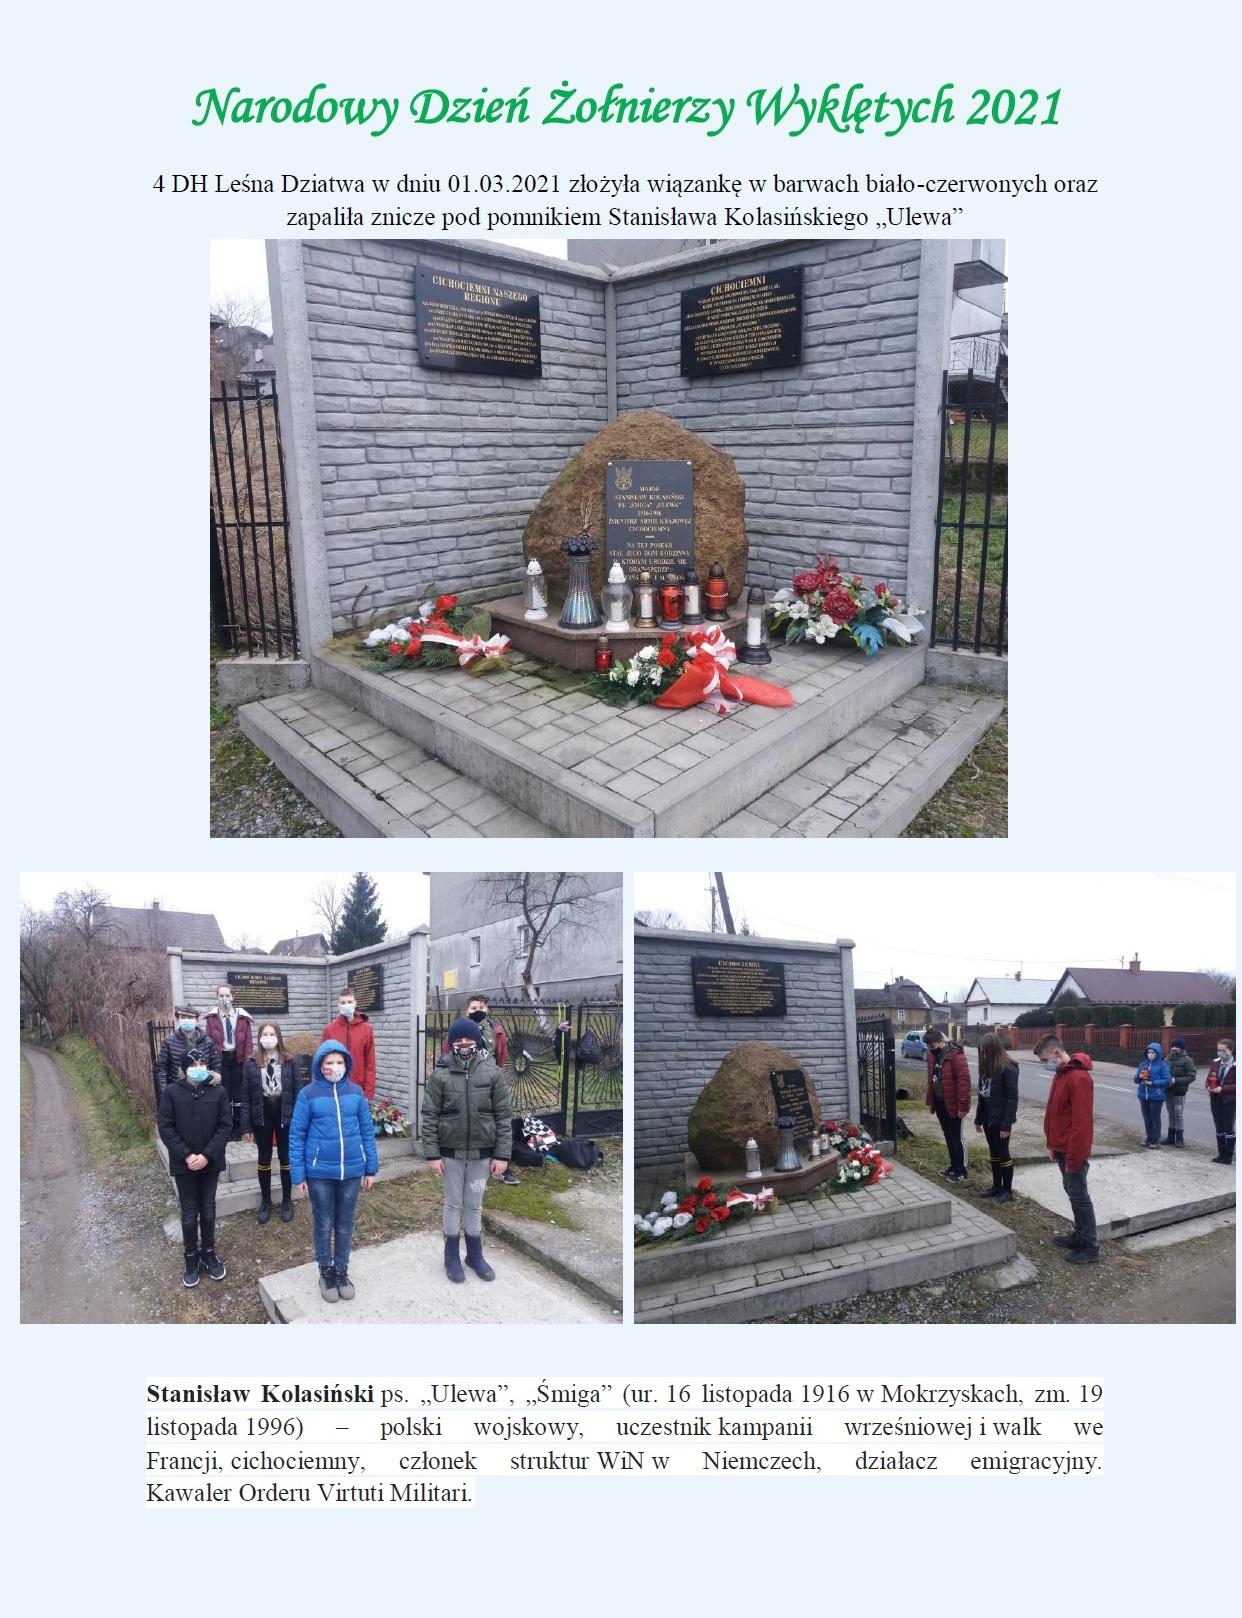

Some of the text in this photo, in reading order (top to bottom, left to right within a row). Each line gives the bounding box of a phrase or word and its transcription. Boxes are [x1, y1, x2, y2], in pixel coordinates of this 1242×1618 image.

[432, 275, 528, 302] CICHOCIEMNI NASZEGO
[710, 275, 766, 295] CICHOCIEMNI
[464, 291, 502, 307] REGIONU
[649, 492, 684, 500] KOLASIŃSKI
[621, 557, 647, 565] KTÓRYM
